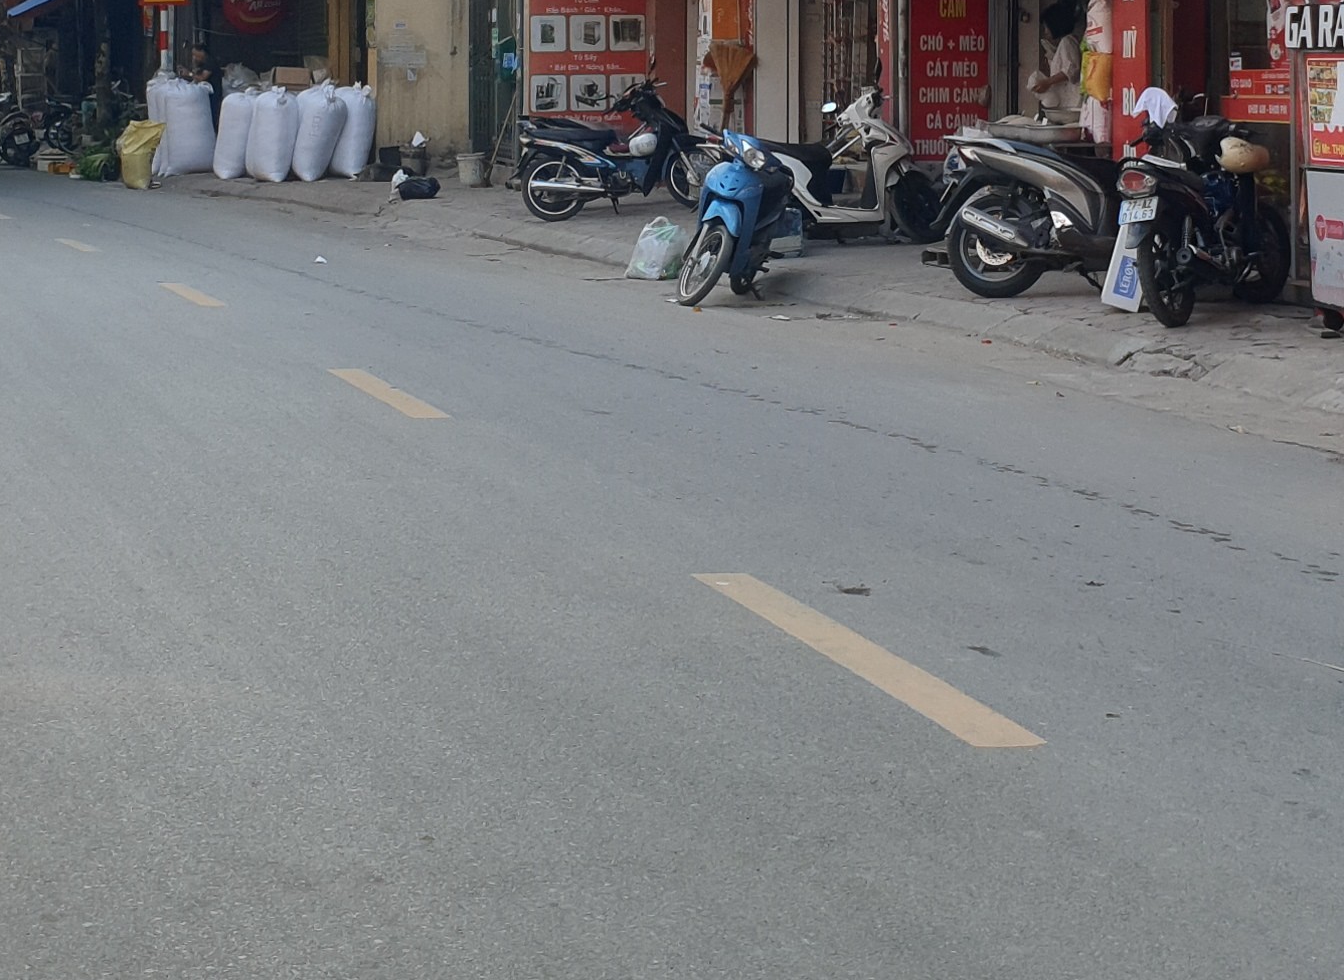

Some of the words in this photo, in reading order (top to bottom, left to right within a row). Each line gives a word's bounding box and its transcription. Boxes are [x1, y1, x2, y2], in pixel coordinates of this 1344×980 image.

[919, 29, 943, 51] CHÓ
[959, 29, 985, 51] MÈO
[926, 61, 949, 77] CÁT
[952, 61, 978, 77] MÈO
[919, 87, 950, 103] CHIM
[926, 109, 942, 129] CÁ
